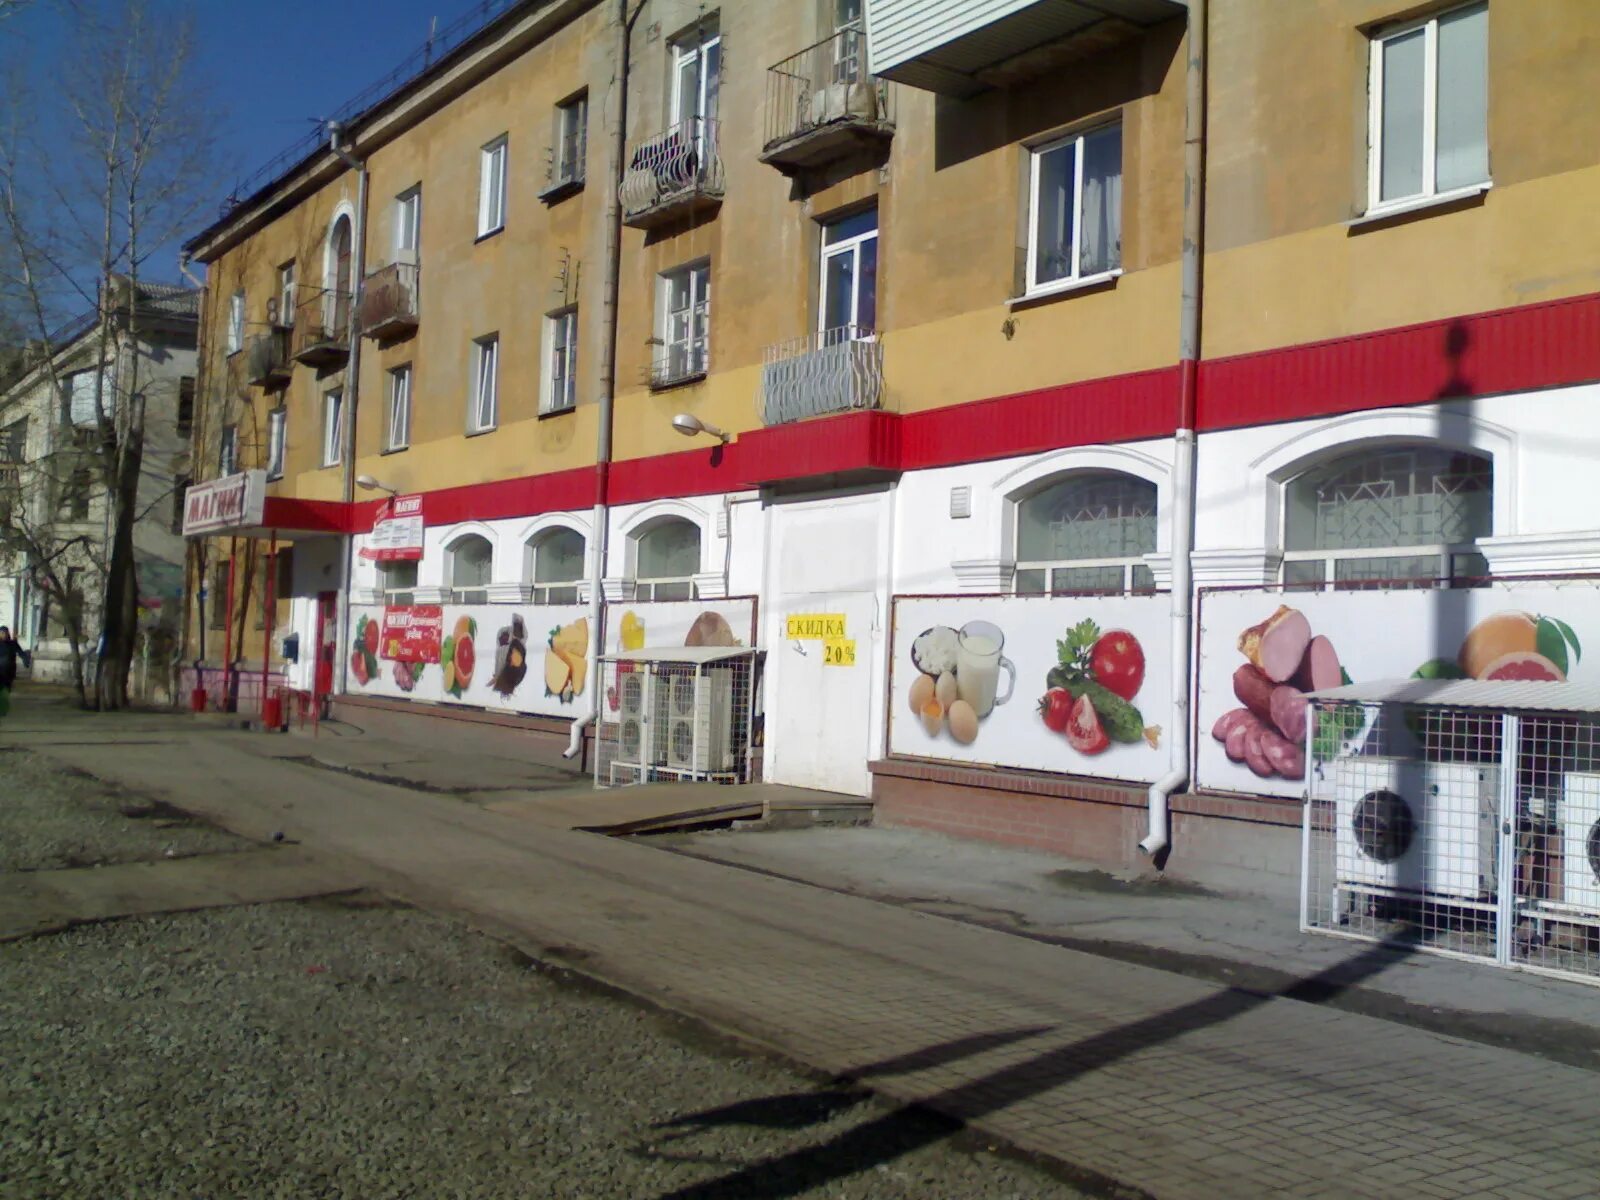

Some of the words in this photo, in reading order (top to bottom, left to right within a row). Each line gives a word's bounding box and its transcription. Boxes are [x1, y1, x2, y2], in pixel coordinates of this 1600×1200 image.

[188, 487, 245, 522] МАГНИТ
[788, 620, 844, 637] СКИДКА
[826, 646, 854, 662] 20%
